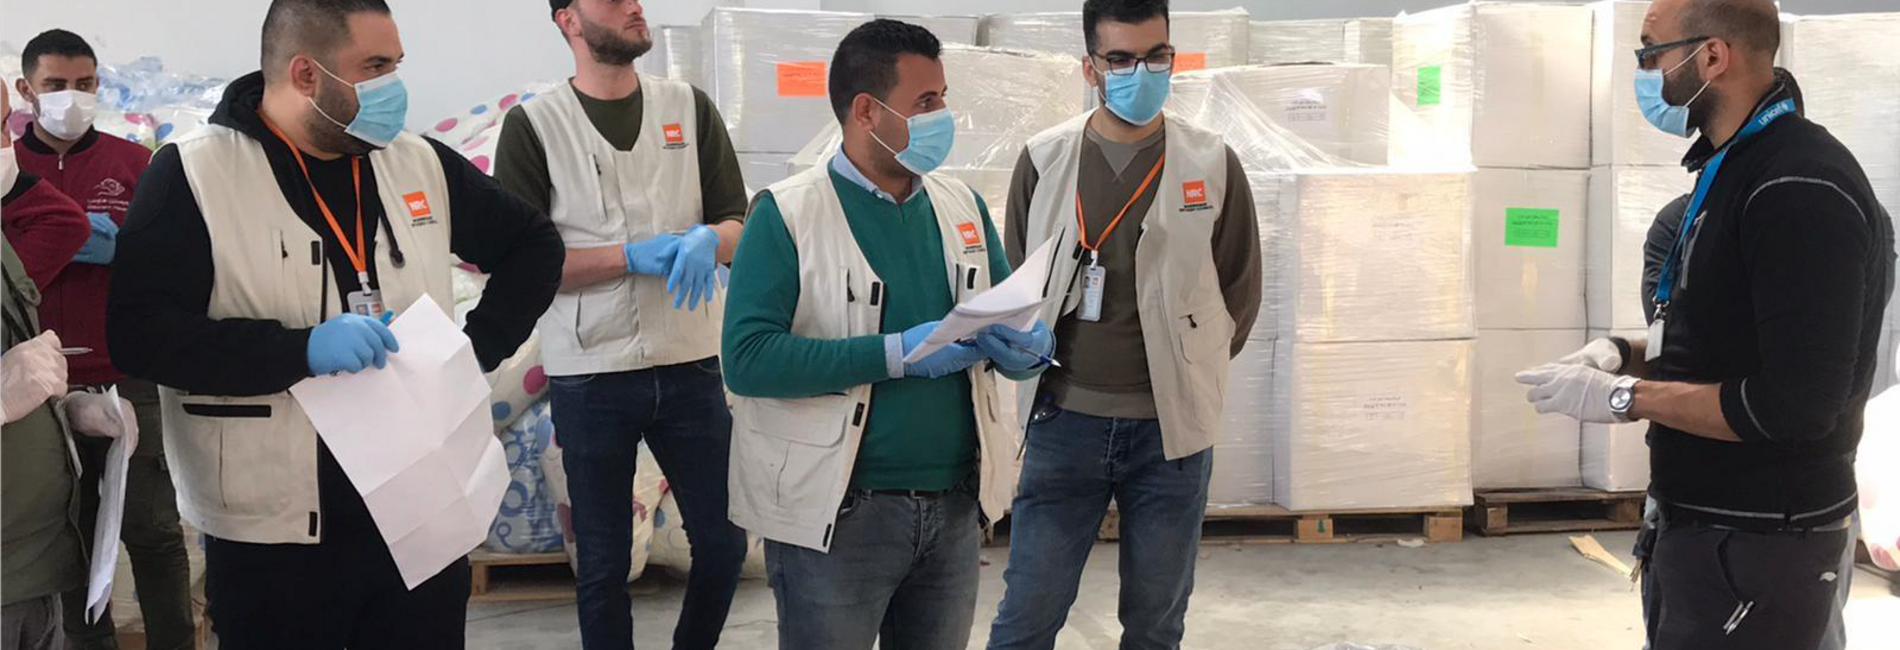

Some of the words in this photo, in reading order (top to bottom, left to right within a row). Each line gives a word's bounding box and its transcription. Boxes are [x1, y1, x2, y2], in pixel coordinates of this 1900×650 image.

[666, 130, 681, 138] NRC
[1186, 188, 1203, 198] NRC
[409, 200, 427, 211] NRC
[962, 230, 979, 239] NRC
